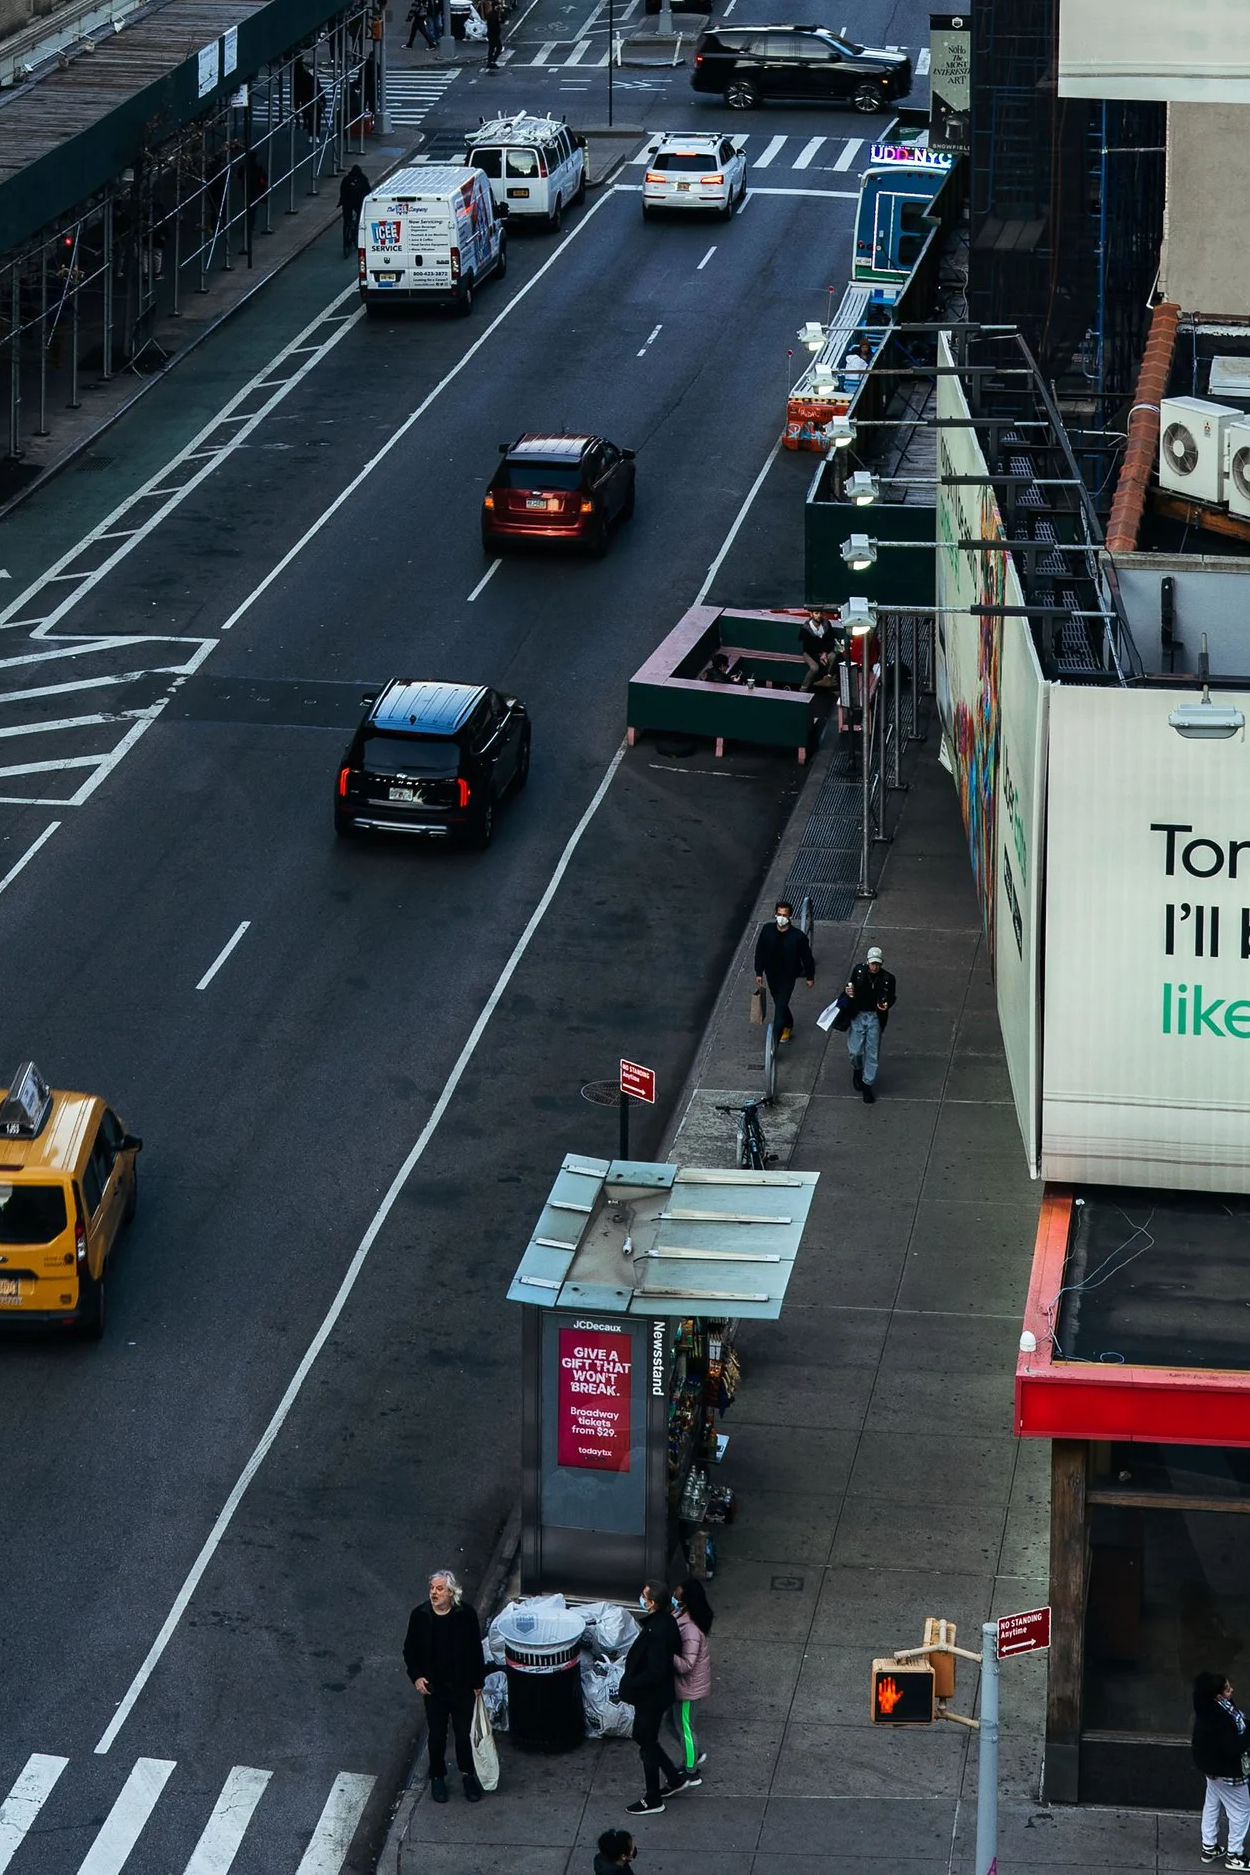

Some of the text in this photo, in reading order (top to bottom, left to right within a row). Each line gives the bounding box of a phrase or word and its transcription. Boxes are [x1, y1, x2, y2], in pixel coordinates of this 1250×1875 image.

[948, 45, 966, 54] NoHo
[945, 61, 969, 69] MOST
[947, 76, 966, 85] ART
[622, 1063, 650, 1080] NO STANDING
[623, 1071, 640, 1083] Anytime
[573, 1320, 622, 1333] JCDecaux
[573, 1347, 619, 1362] GIVE A
[652, 1321, 666, 1397] Newsstand
[562, 1358, 631, 1374] GIFT THAT
[572, 1370, 618, 1385] WON'T
[570, 1382, 621, 1396] BREAK.
[570, 1406, 619, 1421] Broadway
[577, 1417, 611, 1428] tickets
[571, 1425, 617, 1438] from $29.
[1000, 1613, 1042, 1630] NO STANDING
[1000, 1626, 1028, 1639] Anytime
